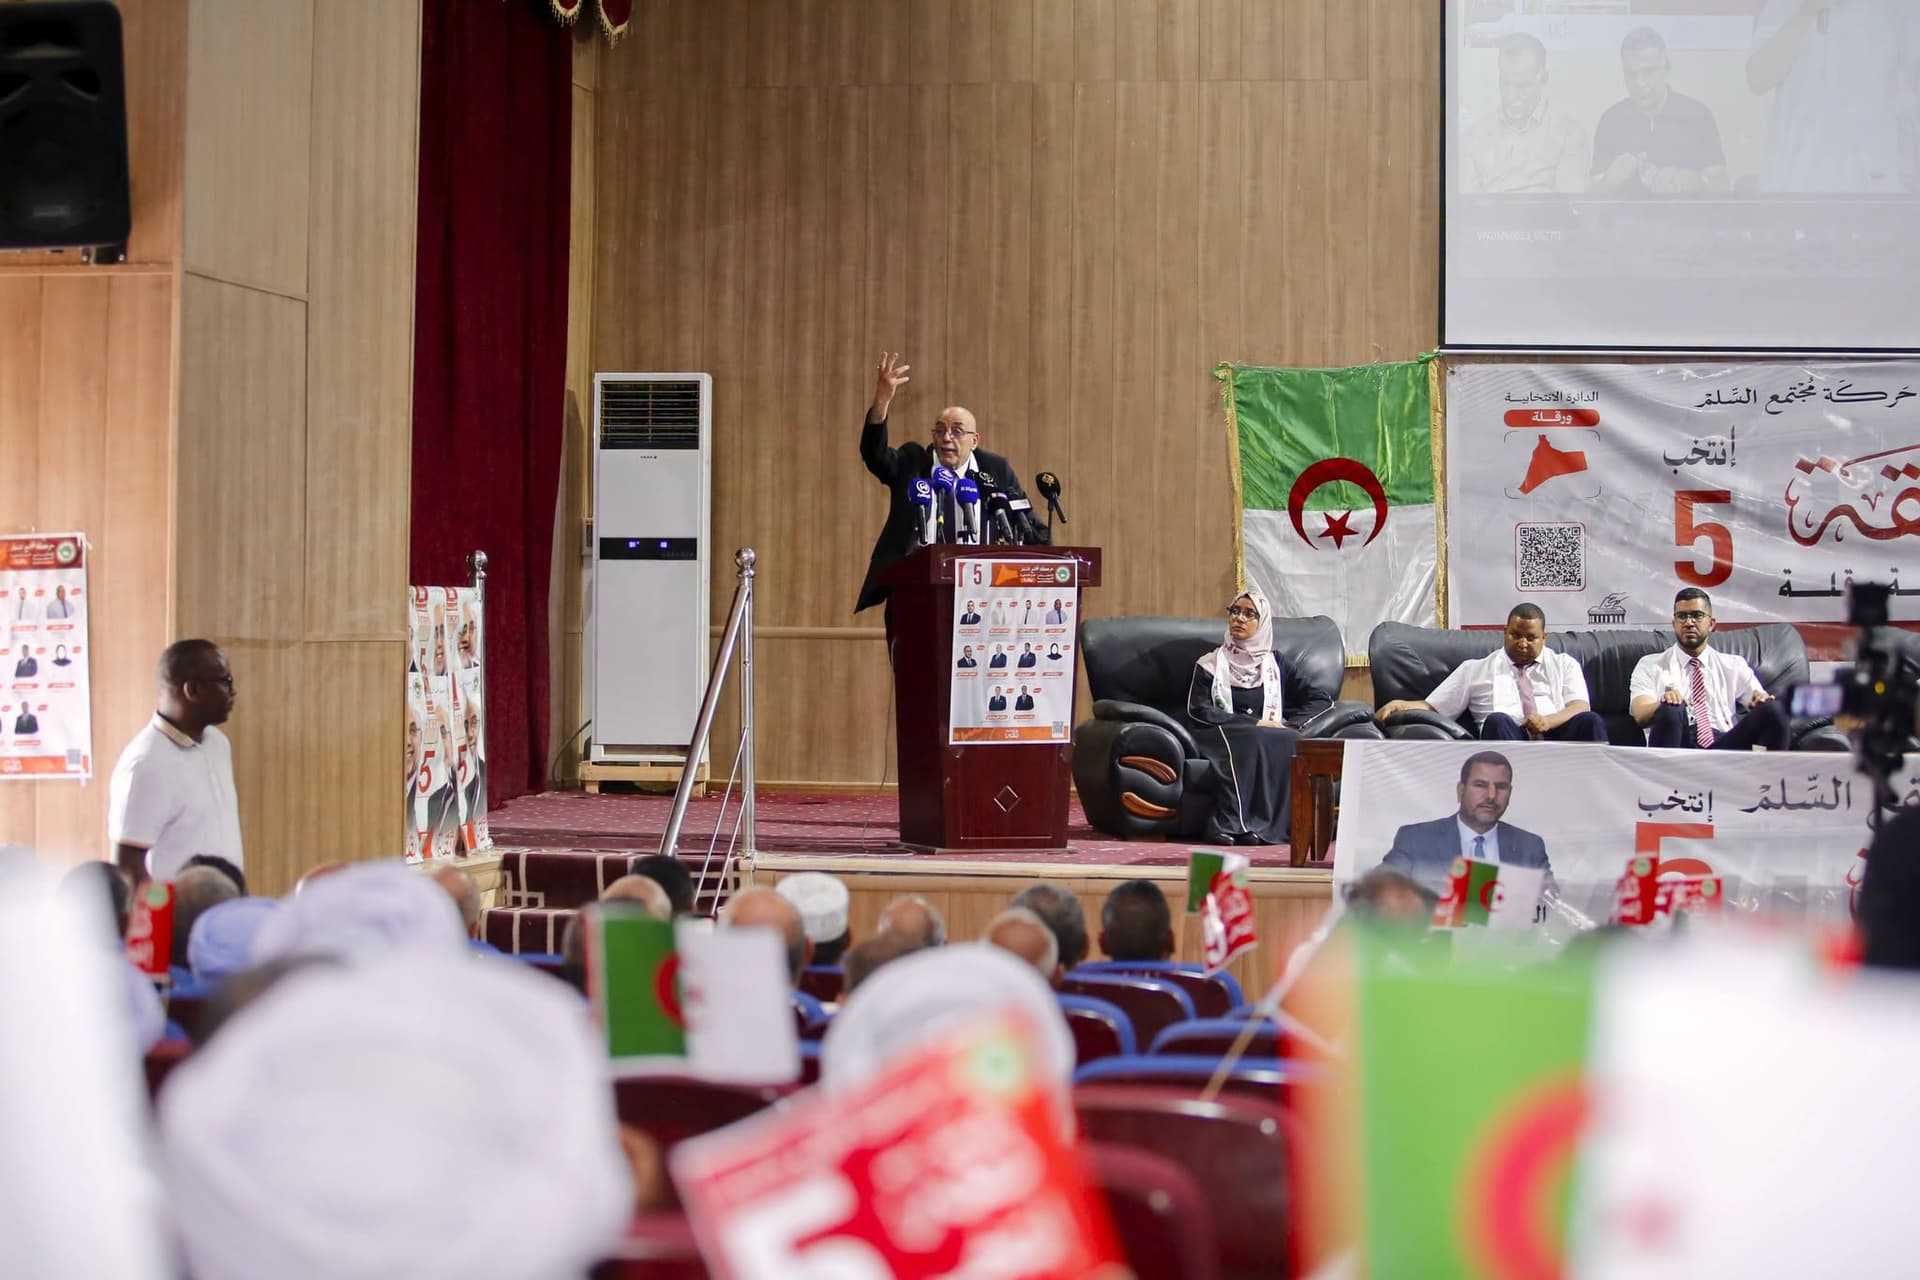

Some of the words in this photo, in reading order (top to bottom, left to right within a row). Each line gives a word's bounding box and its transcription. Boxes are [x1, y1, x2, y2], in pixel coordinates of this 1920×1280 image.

[1531, 410, 1573, 425] ورقلة
[1674, 490, 1734, 588] 5
[973, 564, 982, 585] 5
[418, 750, 436, 793] 5
